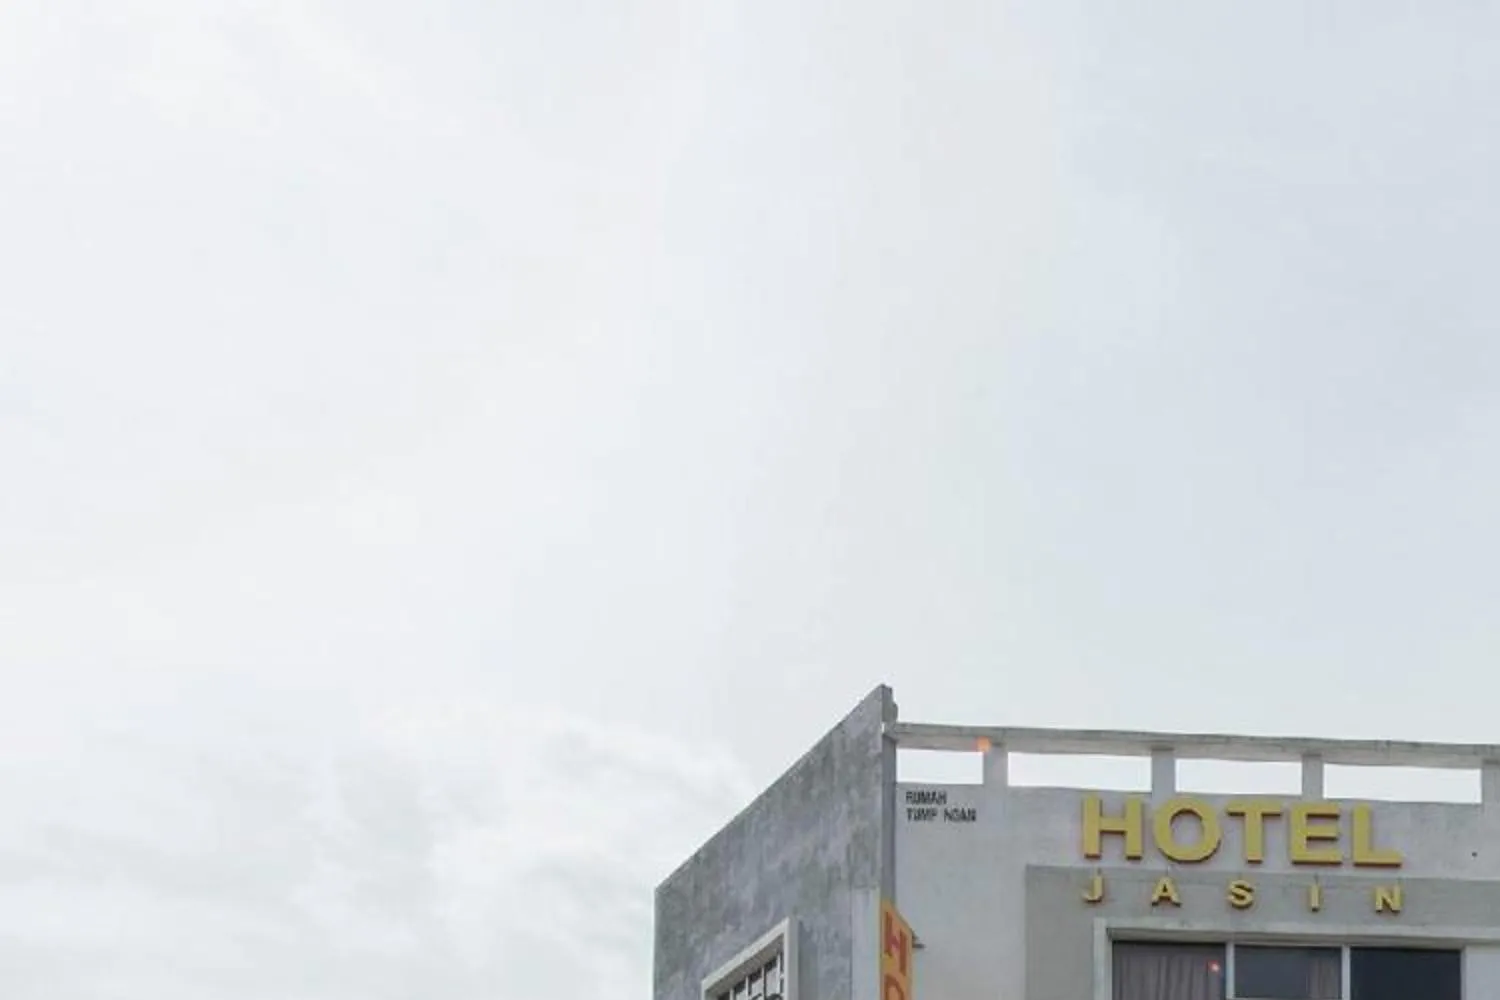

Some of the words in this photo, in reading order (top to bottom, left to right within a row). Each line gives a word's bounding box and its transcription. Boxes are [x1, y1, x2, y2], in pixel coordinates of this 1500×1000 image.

[905, 790, 947, 804] RUMAH
[1080, 795, 1403, 866] HOTEL
[1082, 874, 1403, 912] JASIN
